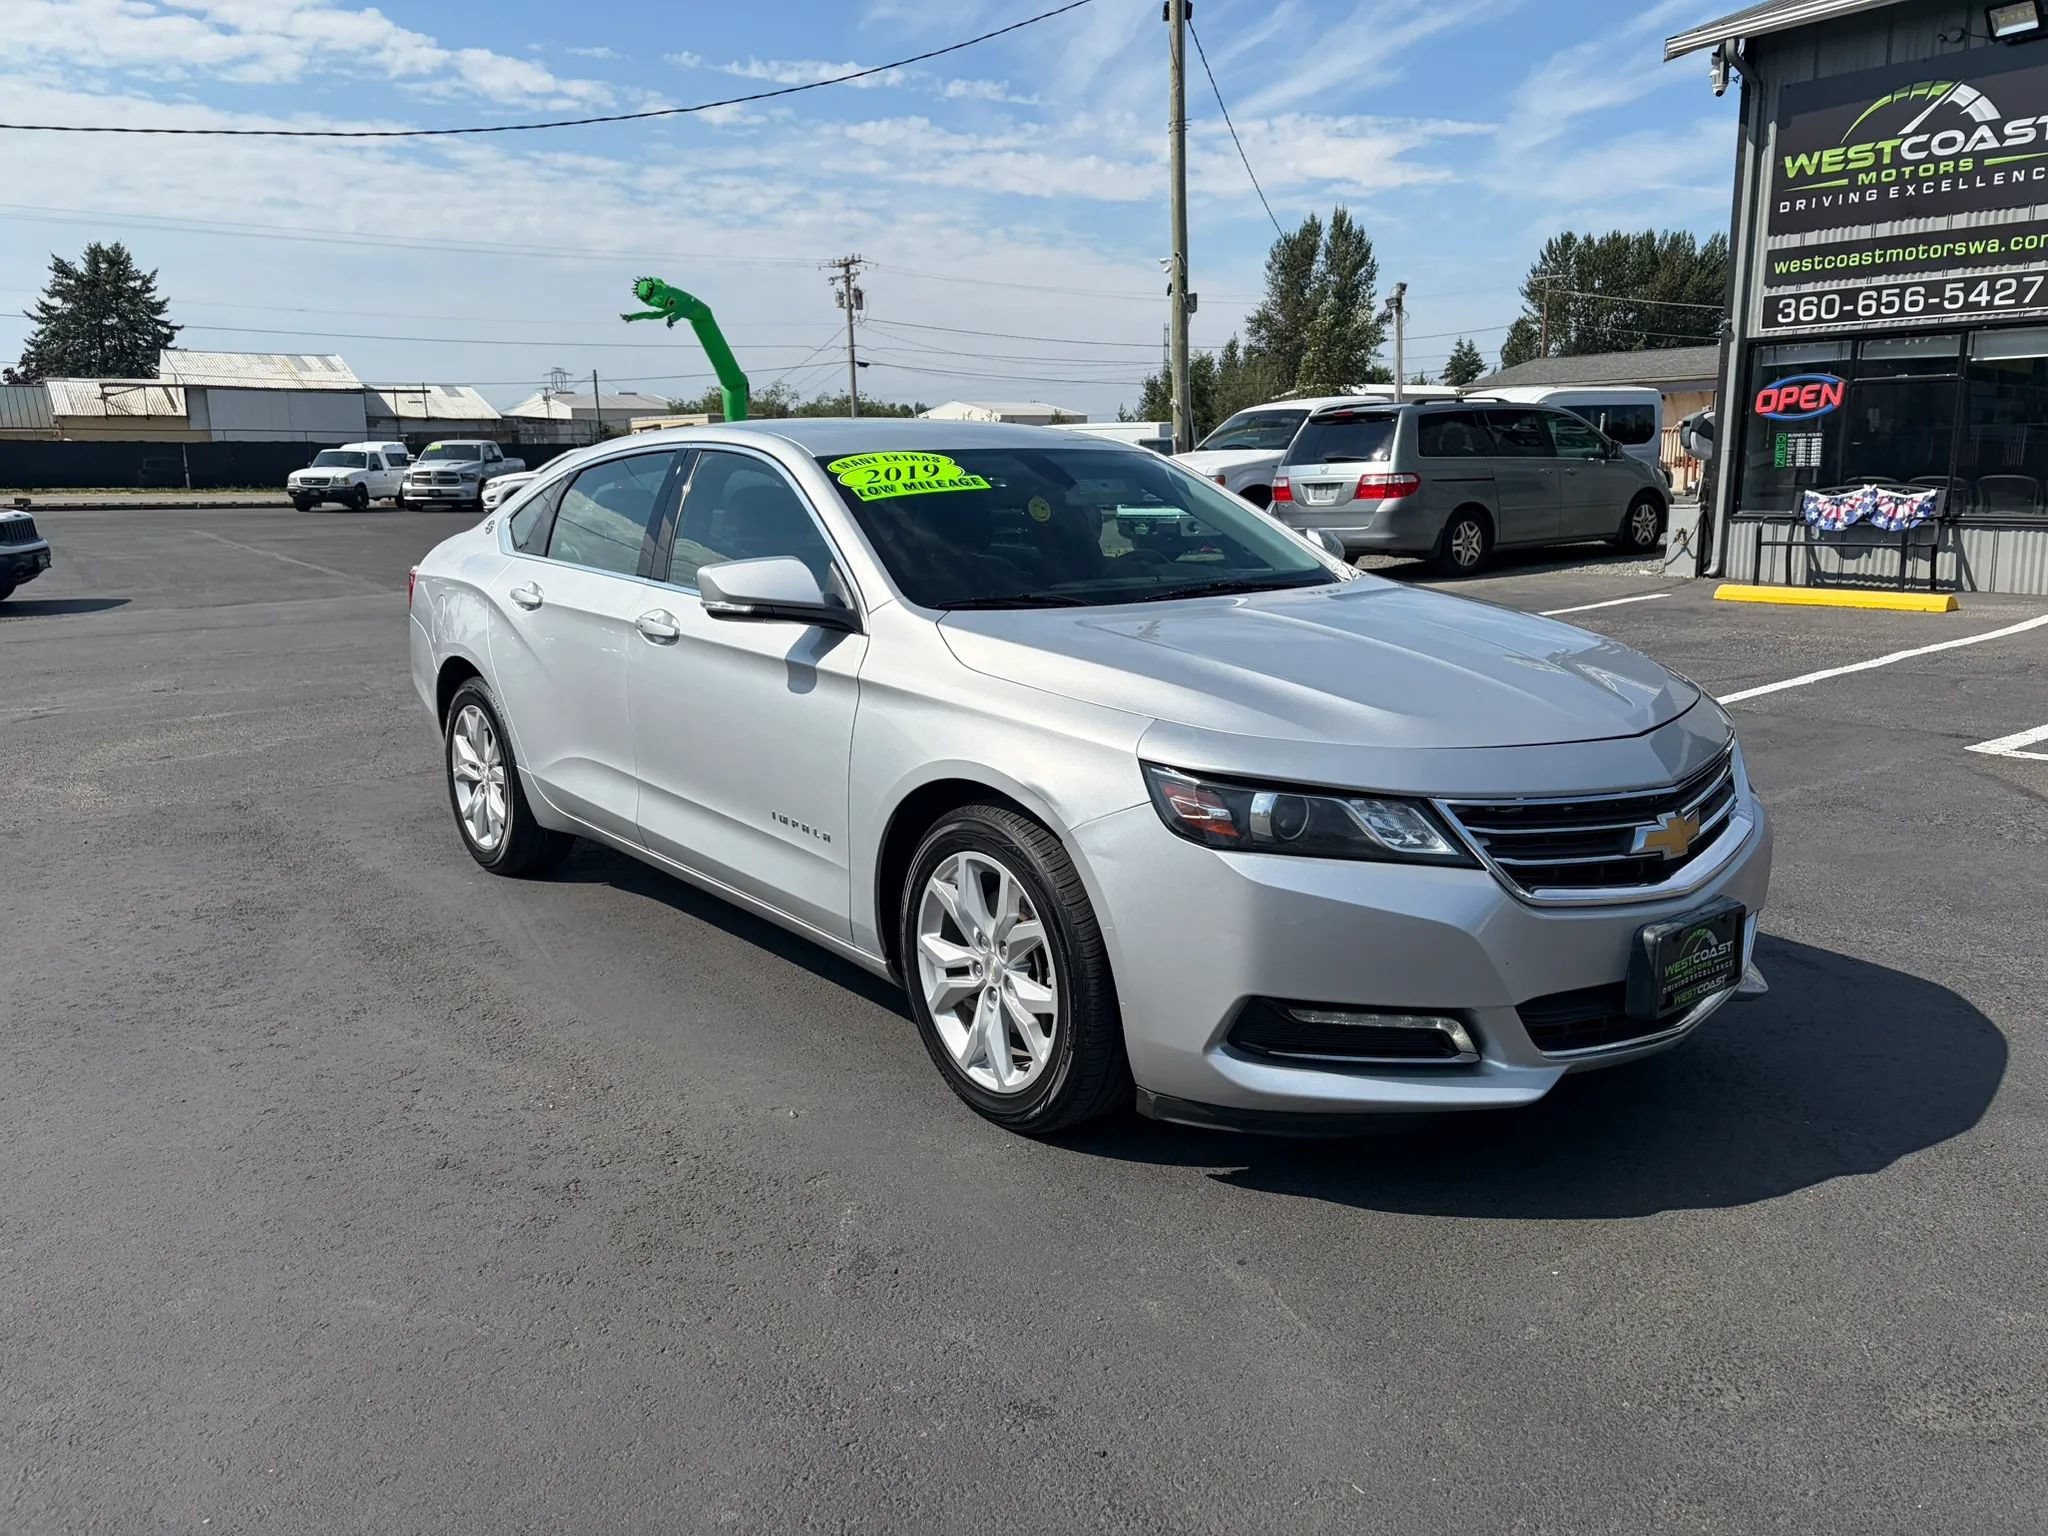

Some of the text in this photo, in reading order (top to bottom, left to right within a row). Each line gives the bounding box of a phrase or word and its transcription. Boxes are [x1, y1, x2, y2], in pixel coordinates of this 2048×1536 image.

[1858, 158, 1974, 185] MOTORS
[1779, 190, 1878, 213] DRIVING
[1777, 275, 2045, 323] 360-656-5427
[1755, 382, 1846, 415] OPEN
[836, 454, 941, 470] MANY EXTRAS
[864, 463, 940, 484] 2019
[857, 476, 984, 497] LOW MILEAGE
[1664, 940, 1734, 977] WESTCOAST
